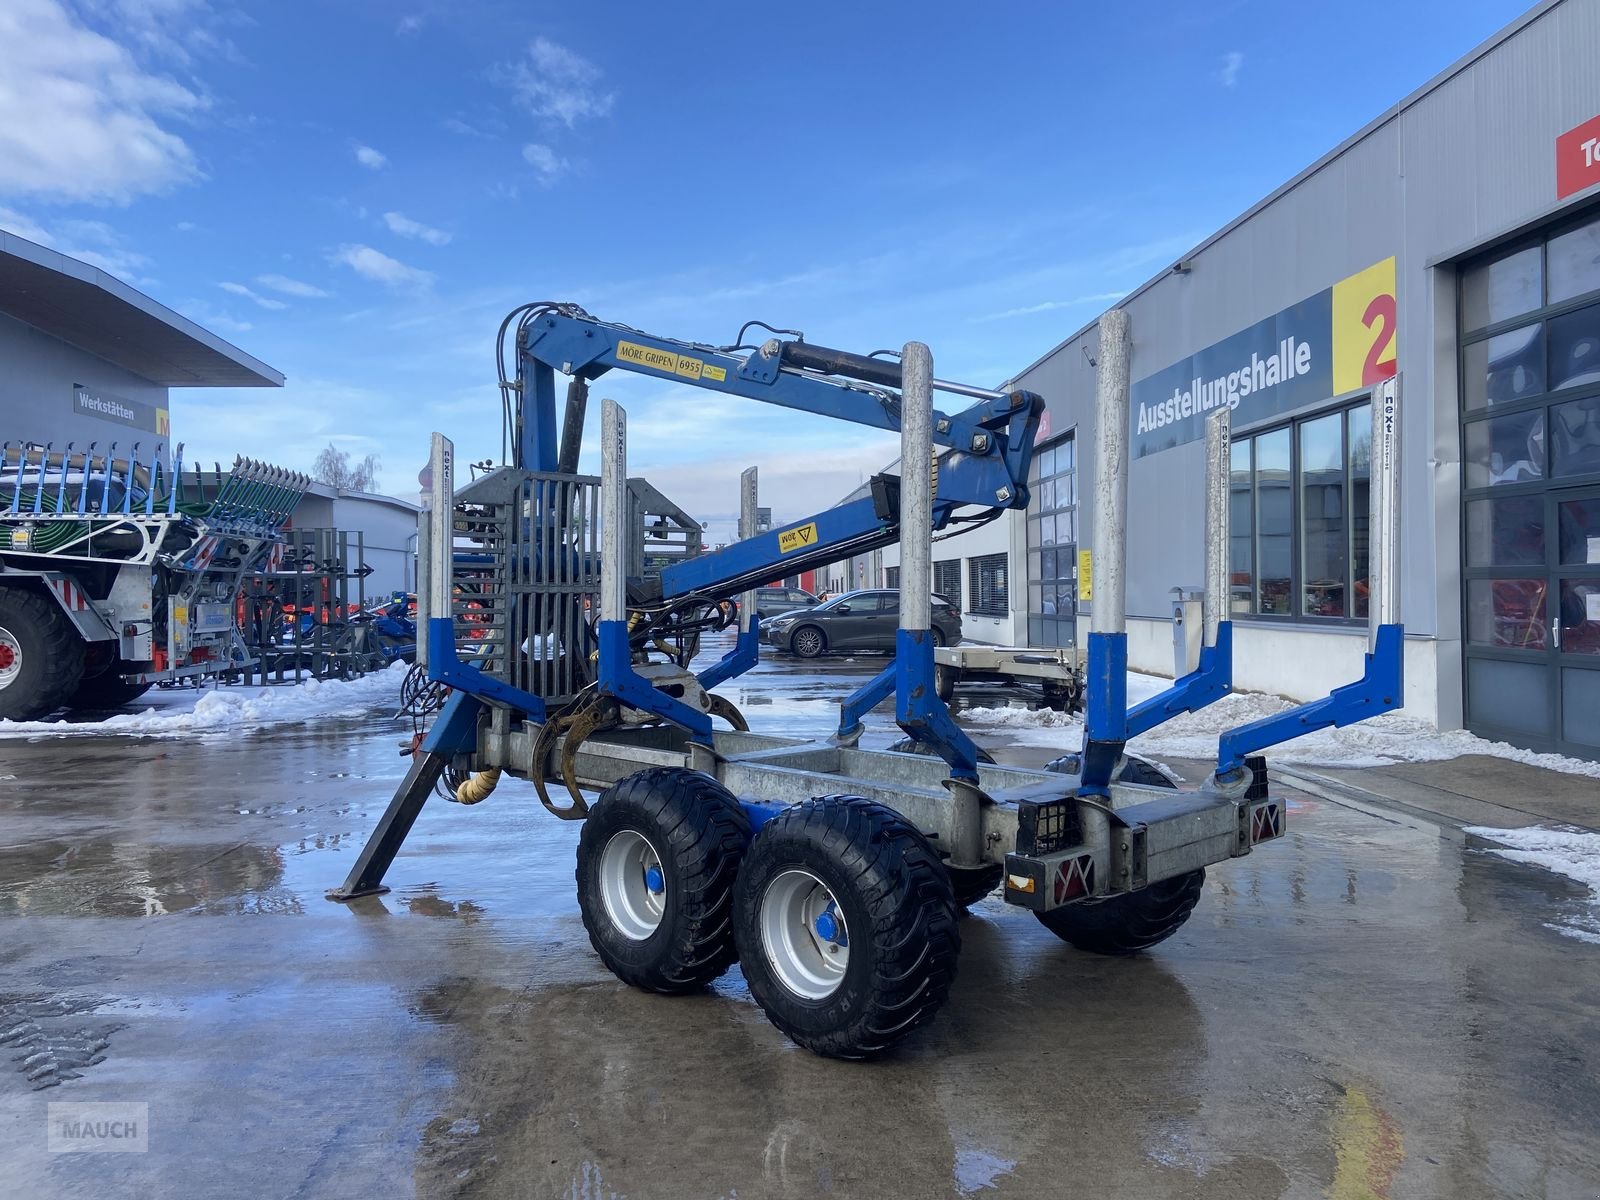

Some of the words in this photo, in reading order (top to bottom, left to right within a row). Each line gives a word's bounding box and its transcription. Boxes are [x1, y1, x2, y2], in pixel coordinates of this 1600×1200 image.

[620, 346, 643, 361] MÖRE
[645, 352, 674, 368] GRIPEN
[679, 359, 700, 373] 6955
[1137, 336, 1311, 435] Ausstellungshalle
[1361, 294, 1396, 386] 2
[79, 392, 134, 420] Werkstätten
[1385, 396, 1393, 432] next
